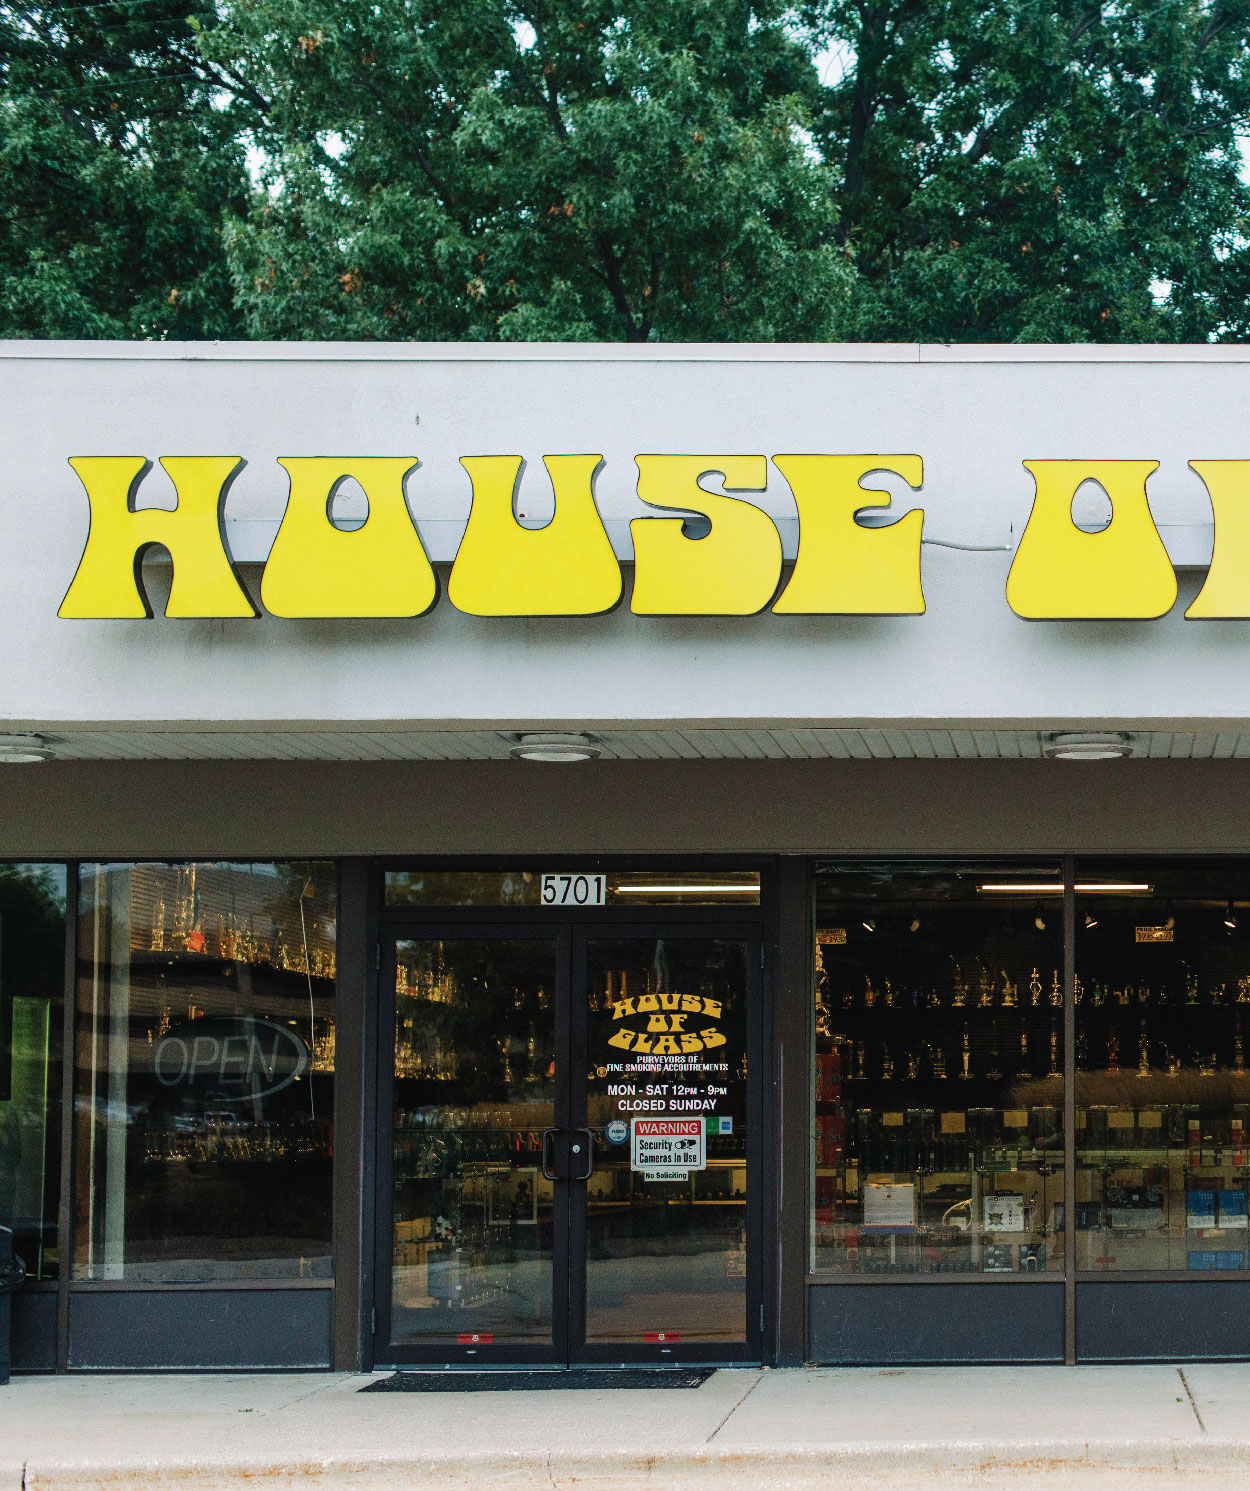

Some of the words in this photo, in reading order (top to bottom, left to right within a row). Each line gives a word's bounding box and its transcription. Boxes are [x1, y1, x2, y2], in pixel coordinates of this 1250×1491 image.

[57, 453, 928, 621] HOUSE
[543, 875, 602, 904] 5701
[612, 993, 723, 1021] HOUSE
[646, 1013, 688, 1033] OF
[607, 1027, 727, 1055] GLASS
[154, 1034, 280, 1086] OPEN
[636, 1055, 687, 1064] PURVEYORS
[688, 1055, 699, 1064] OF
[606, 1063, 624, 1072] FINE
[625, 1063, 659, 1072] SMOKING
[663, 1063, 729, 1072] ACCOUTREMENTS
[607, 1084, 636, 1096] MON
[645, 1084, 669, 1096] SAT
[672, 1084, 698, 1096] 12PM
[707, 1084, 728, 1096] 9PM
[617, 1099, 666, 1111] CLOSED
[669, 1098, 717, 1111] SUNDAY
[638, 1122, 698, 1134] WARNING
[639, 1139, 673, 1151] Security
[639, 1152, 672, 1163] Cameras
[674, 1152, 681, 1163] In
[683, 1152, 697, 1163] Use
[655, 1171, 687, 1180] Soliciting
